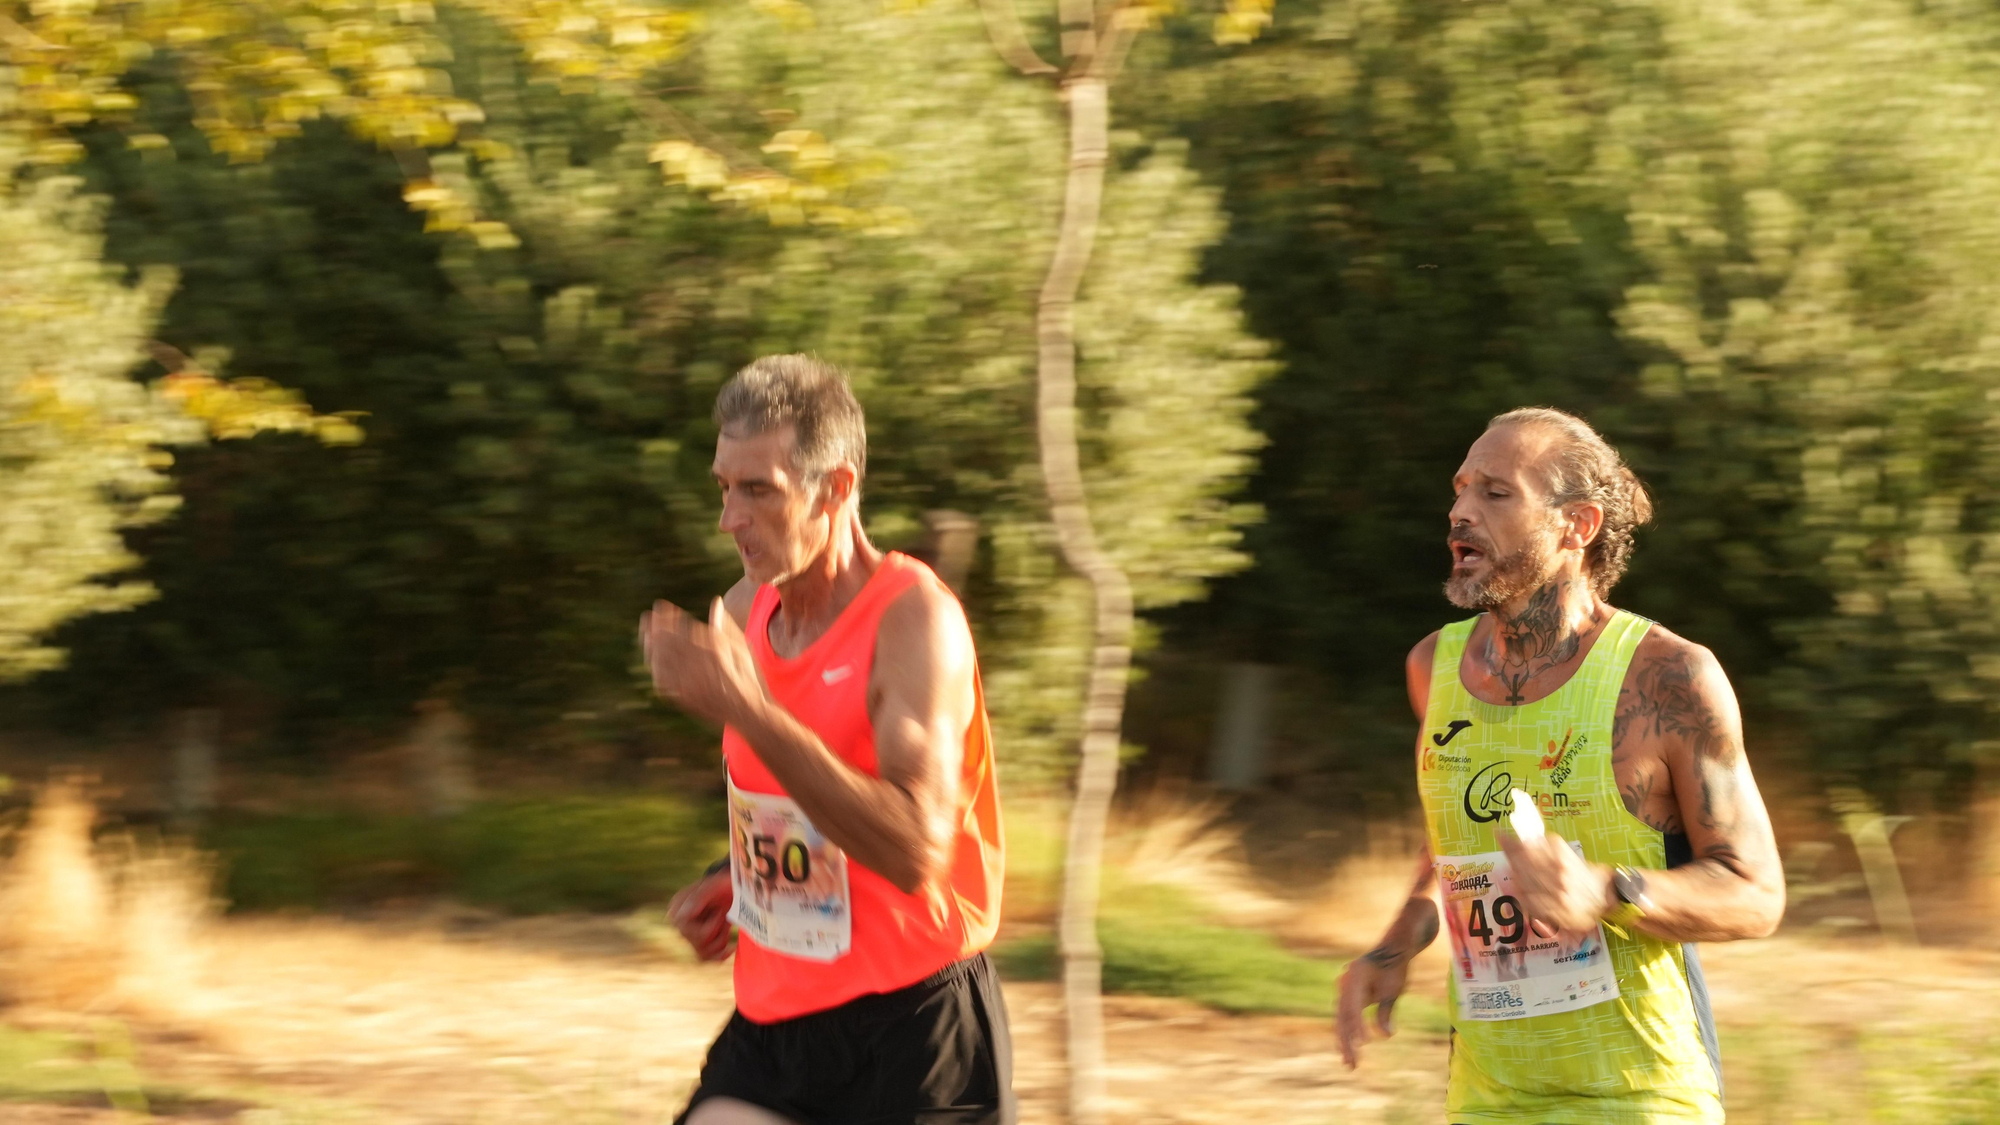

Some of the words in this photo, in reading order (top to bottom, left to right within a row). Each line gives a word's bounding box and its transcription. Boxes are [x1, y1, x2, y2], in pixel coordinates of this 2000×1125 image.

[1438, 754, 1472, 764] Diputación
[1553, 767, 1572, 789] 2020
[1497, 945, 1530, 956] BARRERA
[1531, 941, 1560, 950] BARRIOS
[1553, 949, 1597, 965] serizona
